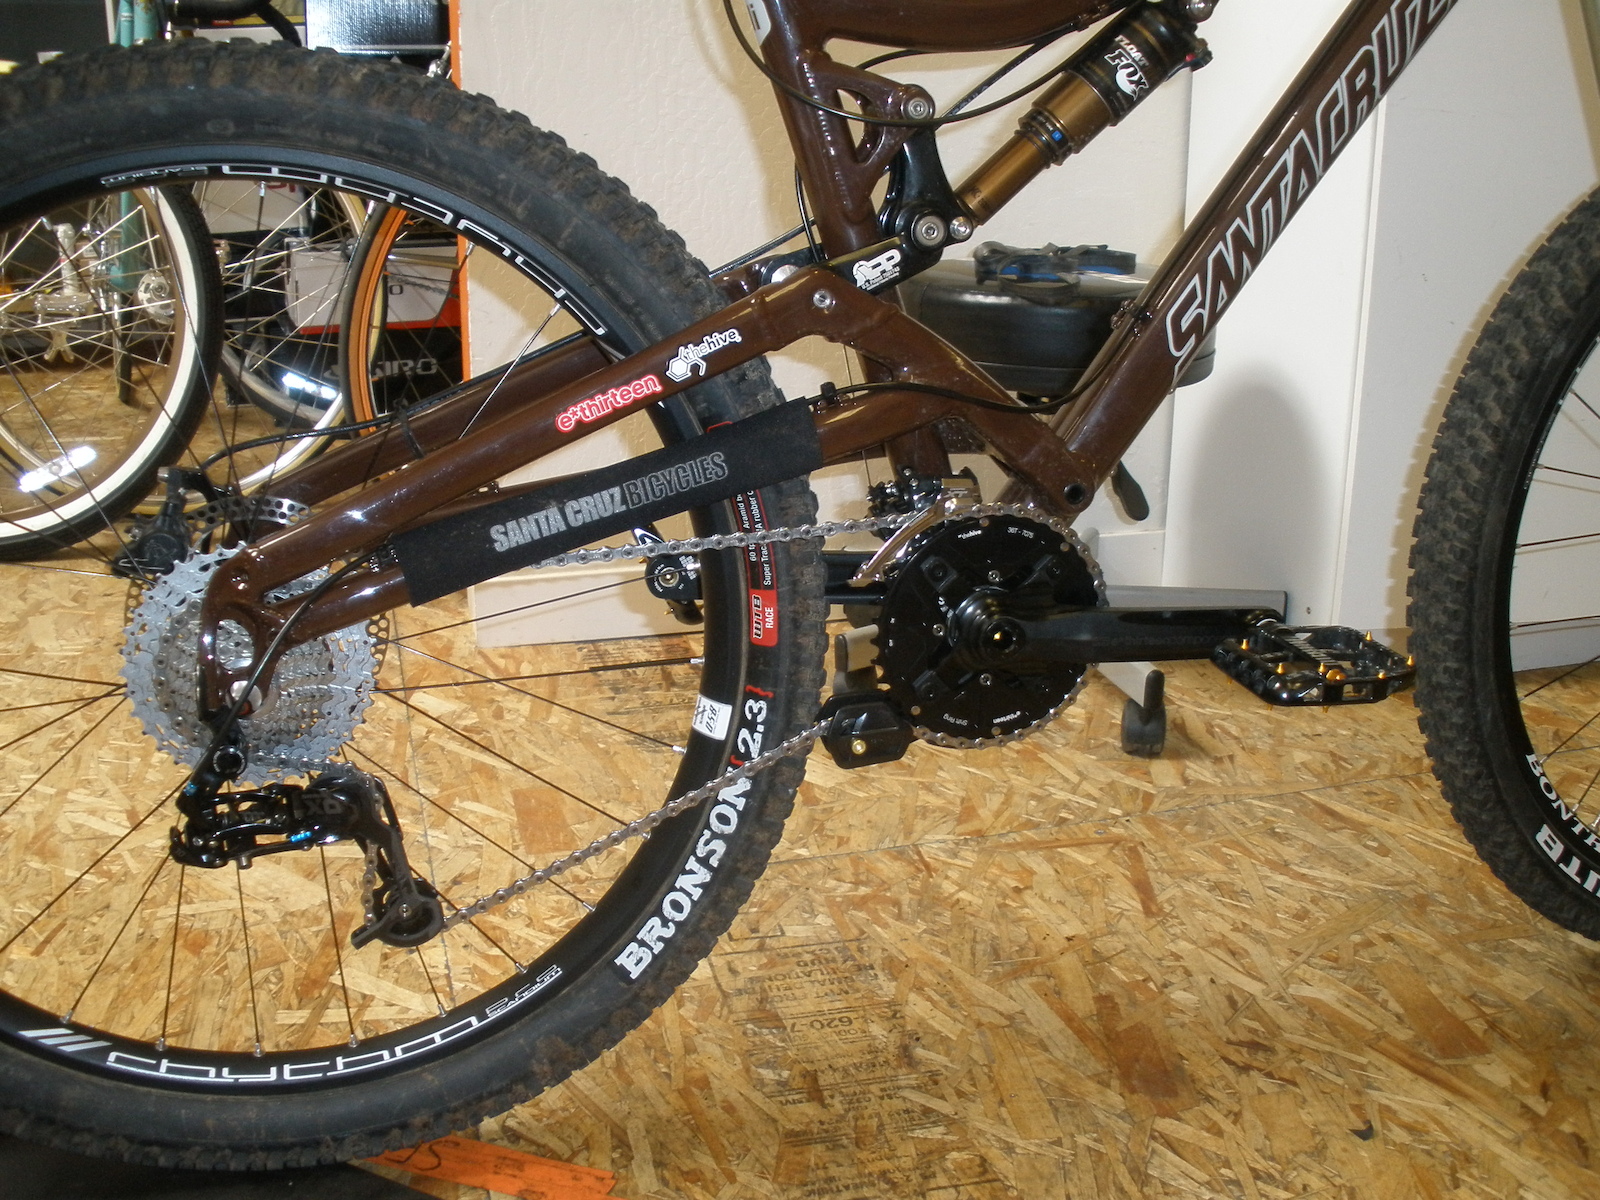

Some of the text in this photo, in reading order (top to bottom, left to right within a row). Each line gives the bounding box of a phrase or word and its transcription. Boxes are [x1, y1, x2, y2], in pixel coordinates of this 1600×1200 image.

[1115, 35, 1149, 67] FLOAT
[1104, 49, 1149, 101] FOX
[489, 451, 729, 553] SANTA CRUZ BICYCLES
[738, 503, 751, 529] Aramid
[749, 496, 763, 522] rubber
[763, 564, 772, 586] Super
[752, 594, 763, 640] WTB
[764, 607, 774, 629] RACE
[614, 766, 752, 980] BRONSON
